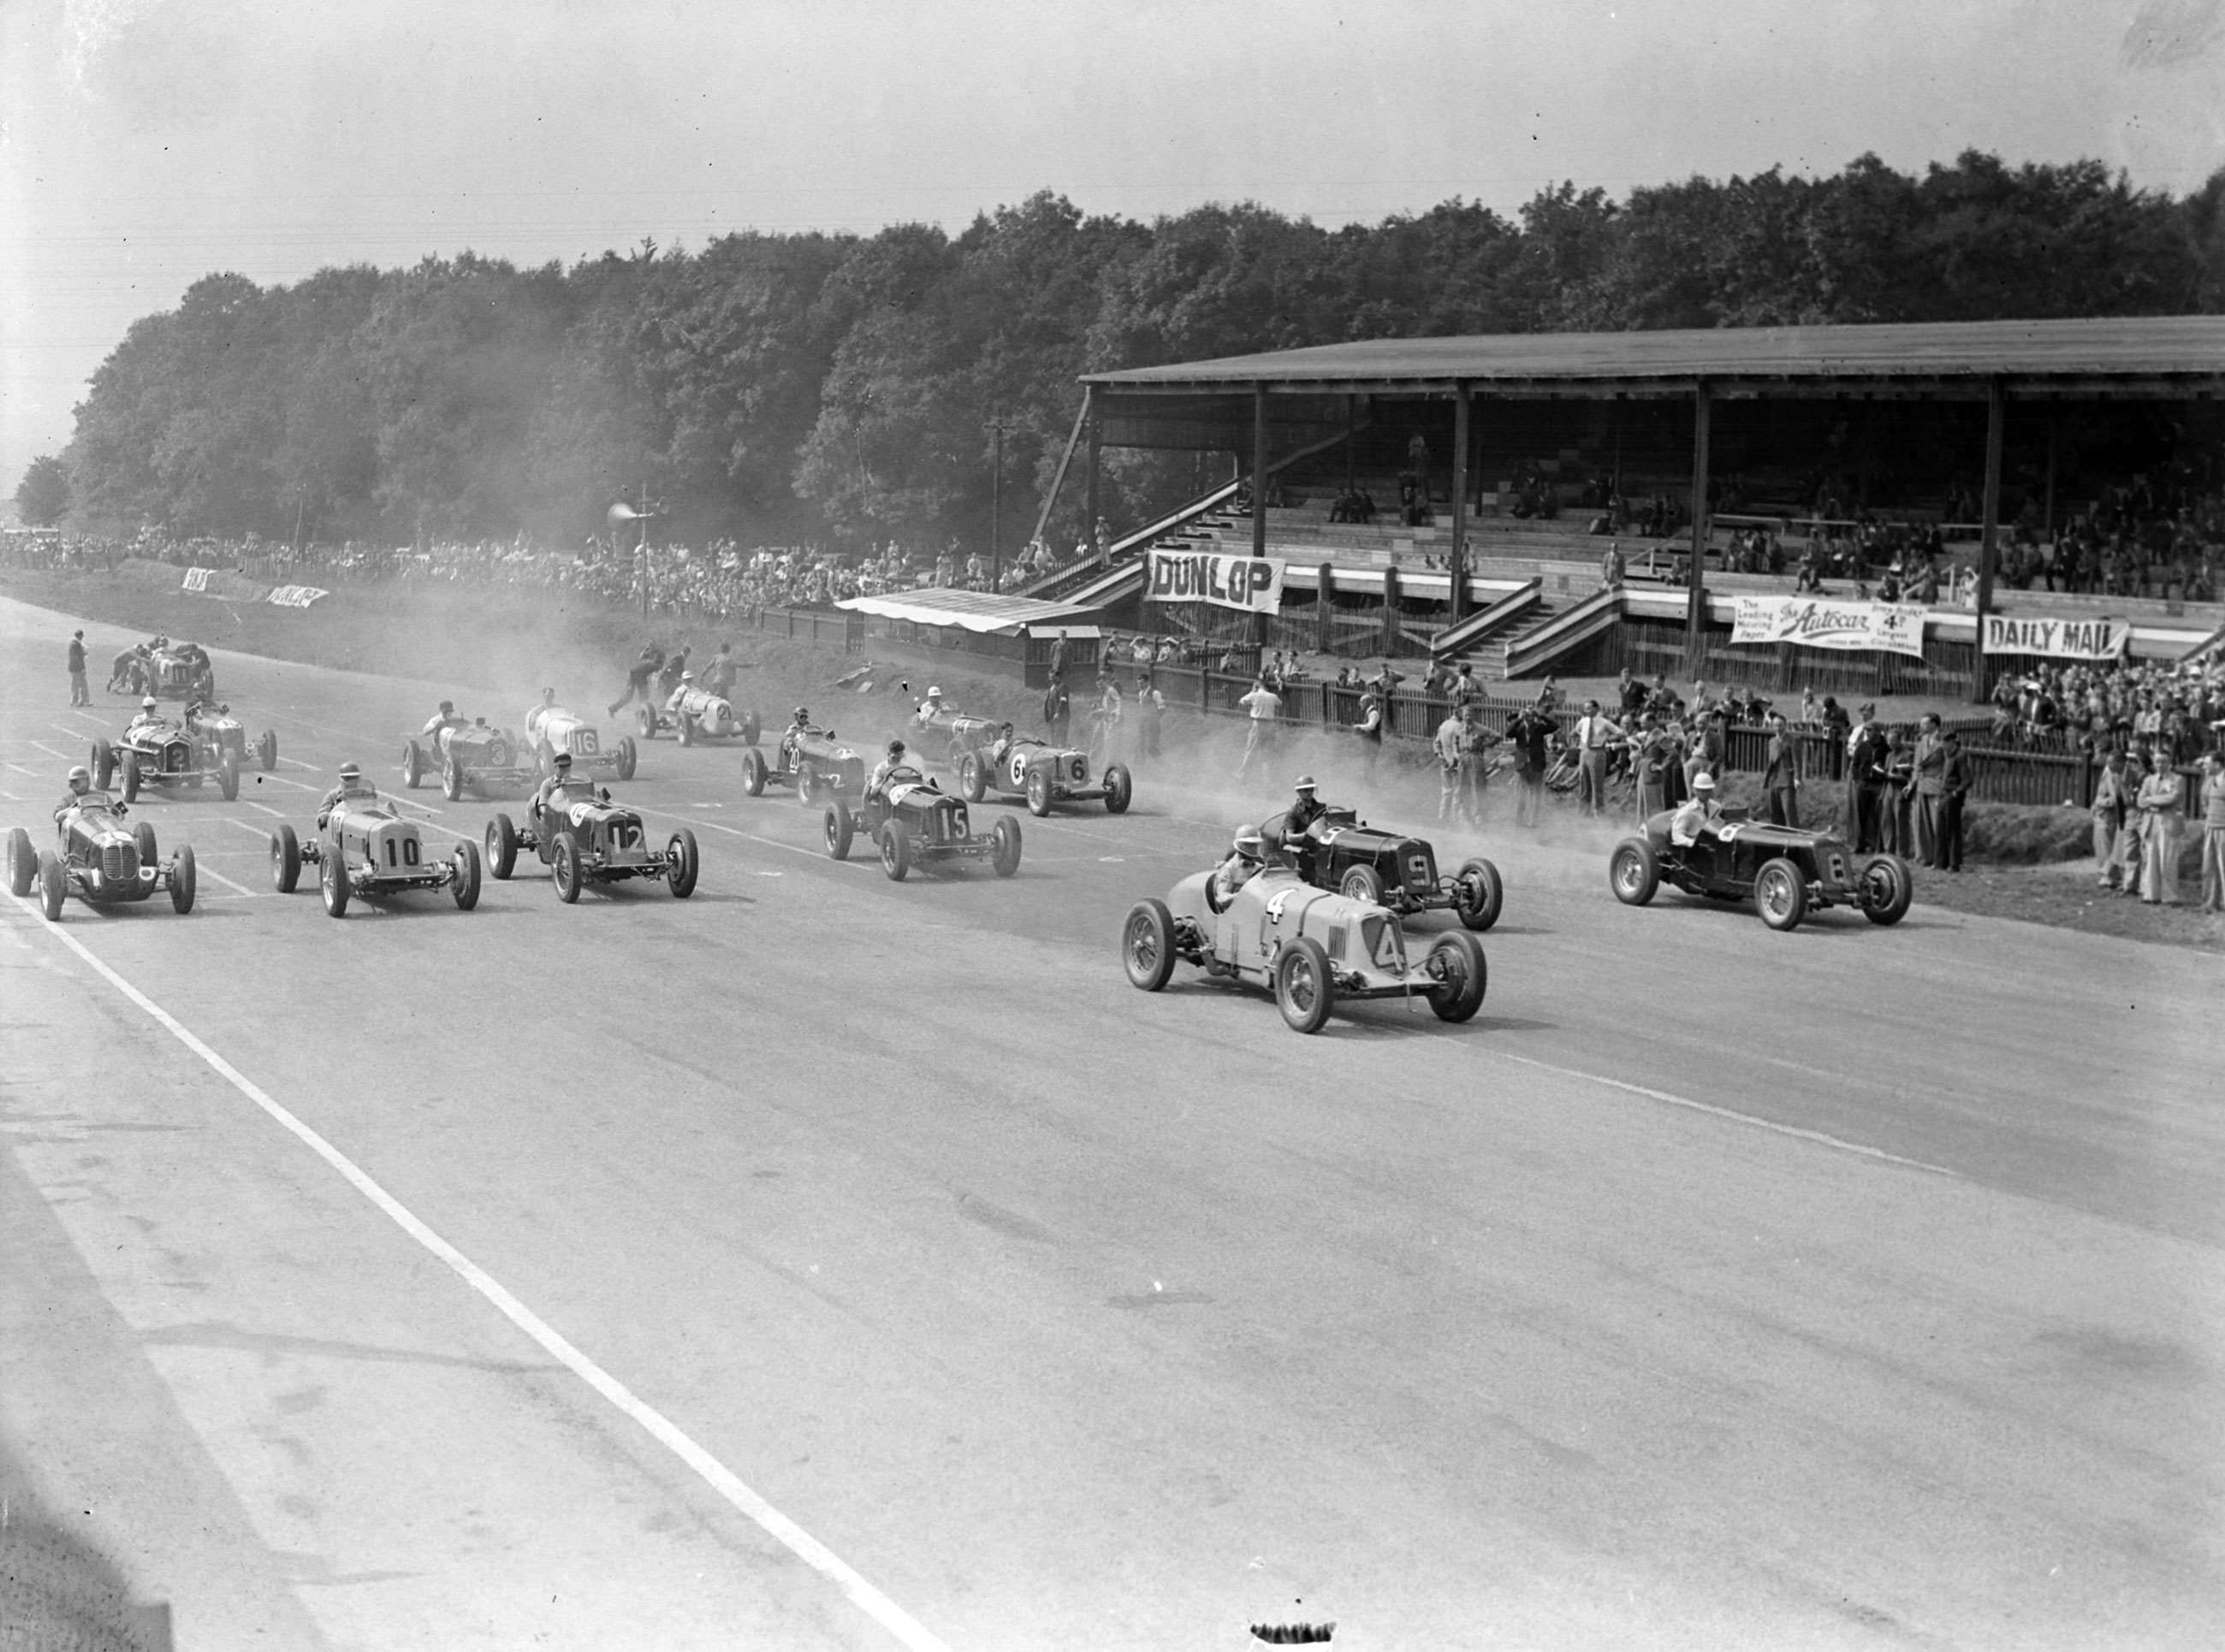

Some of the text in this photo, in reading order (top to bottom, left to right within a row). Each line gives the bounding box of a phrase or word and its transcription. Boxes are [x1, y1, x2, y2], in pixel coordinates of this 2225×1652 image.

[1153, 555, 1272, 606] DUNLOP
[1779, 601, 1871, 637] The Autocar
[1991, 619, 2058, 650] DAILY
[491, 744, 505, 765] 3
[576, 732, 596, 754] 16
[1014, 760, 1022, 779] 6
[1071, 759, 1084, 780] 6
[941, 808, 967, 840] 15
[1319, 827, 1348, 845] 9
[386, 838, 418, 867] 10
[613, 826, 644, 854] 12
[1409, 856, 1431, 886] 9
[1828, 854, 1845, 884] 8
[1267, 889, 1296, 925] 4
